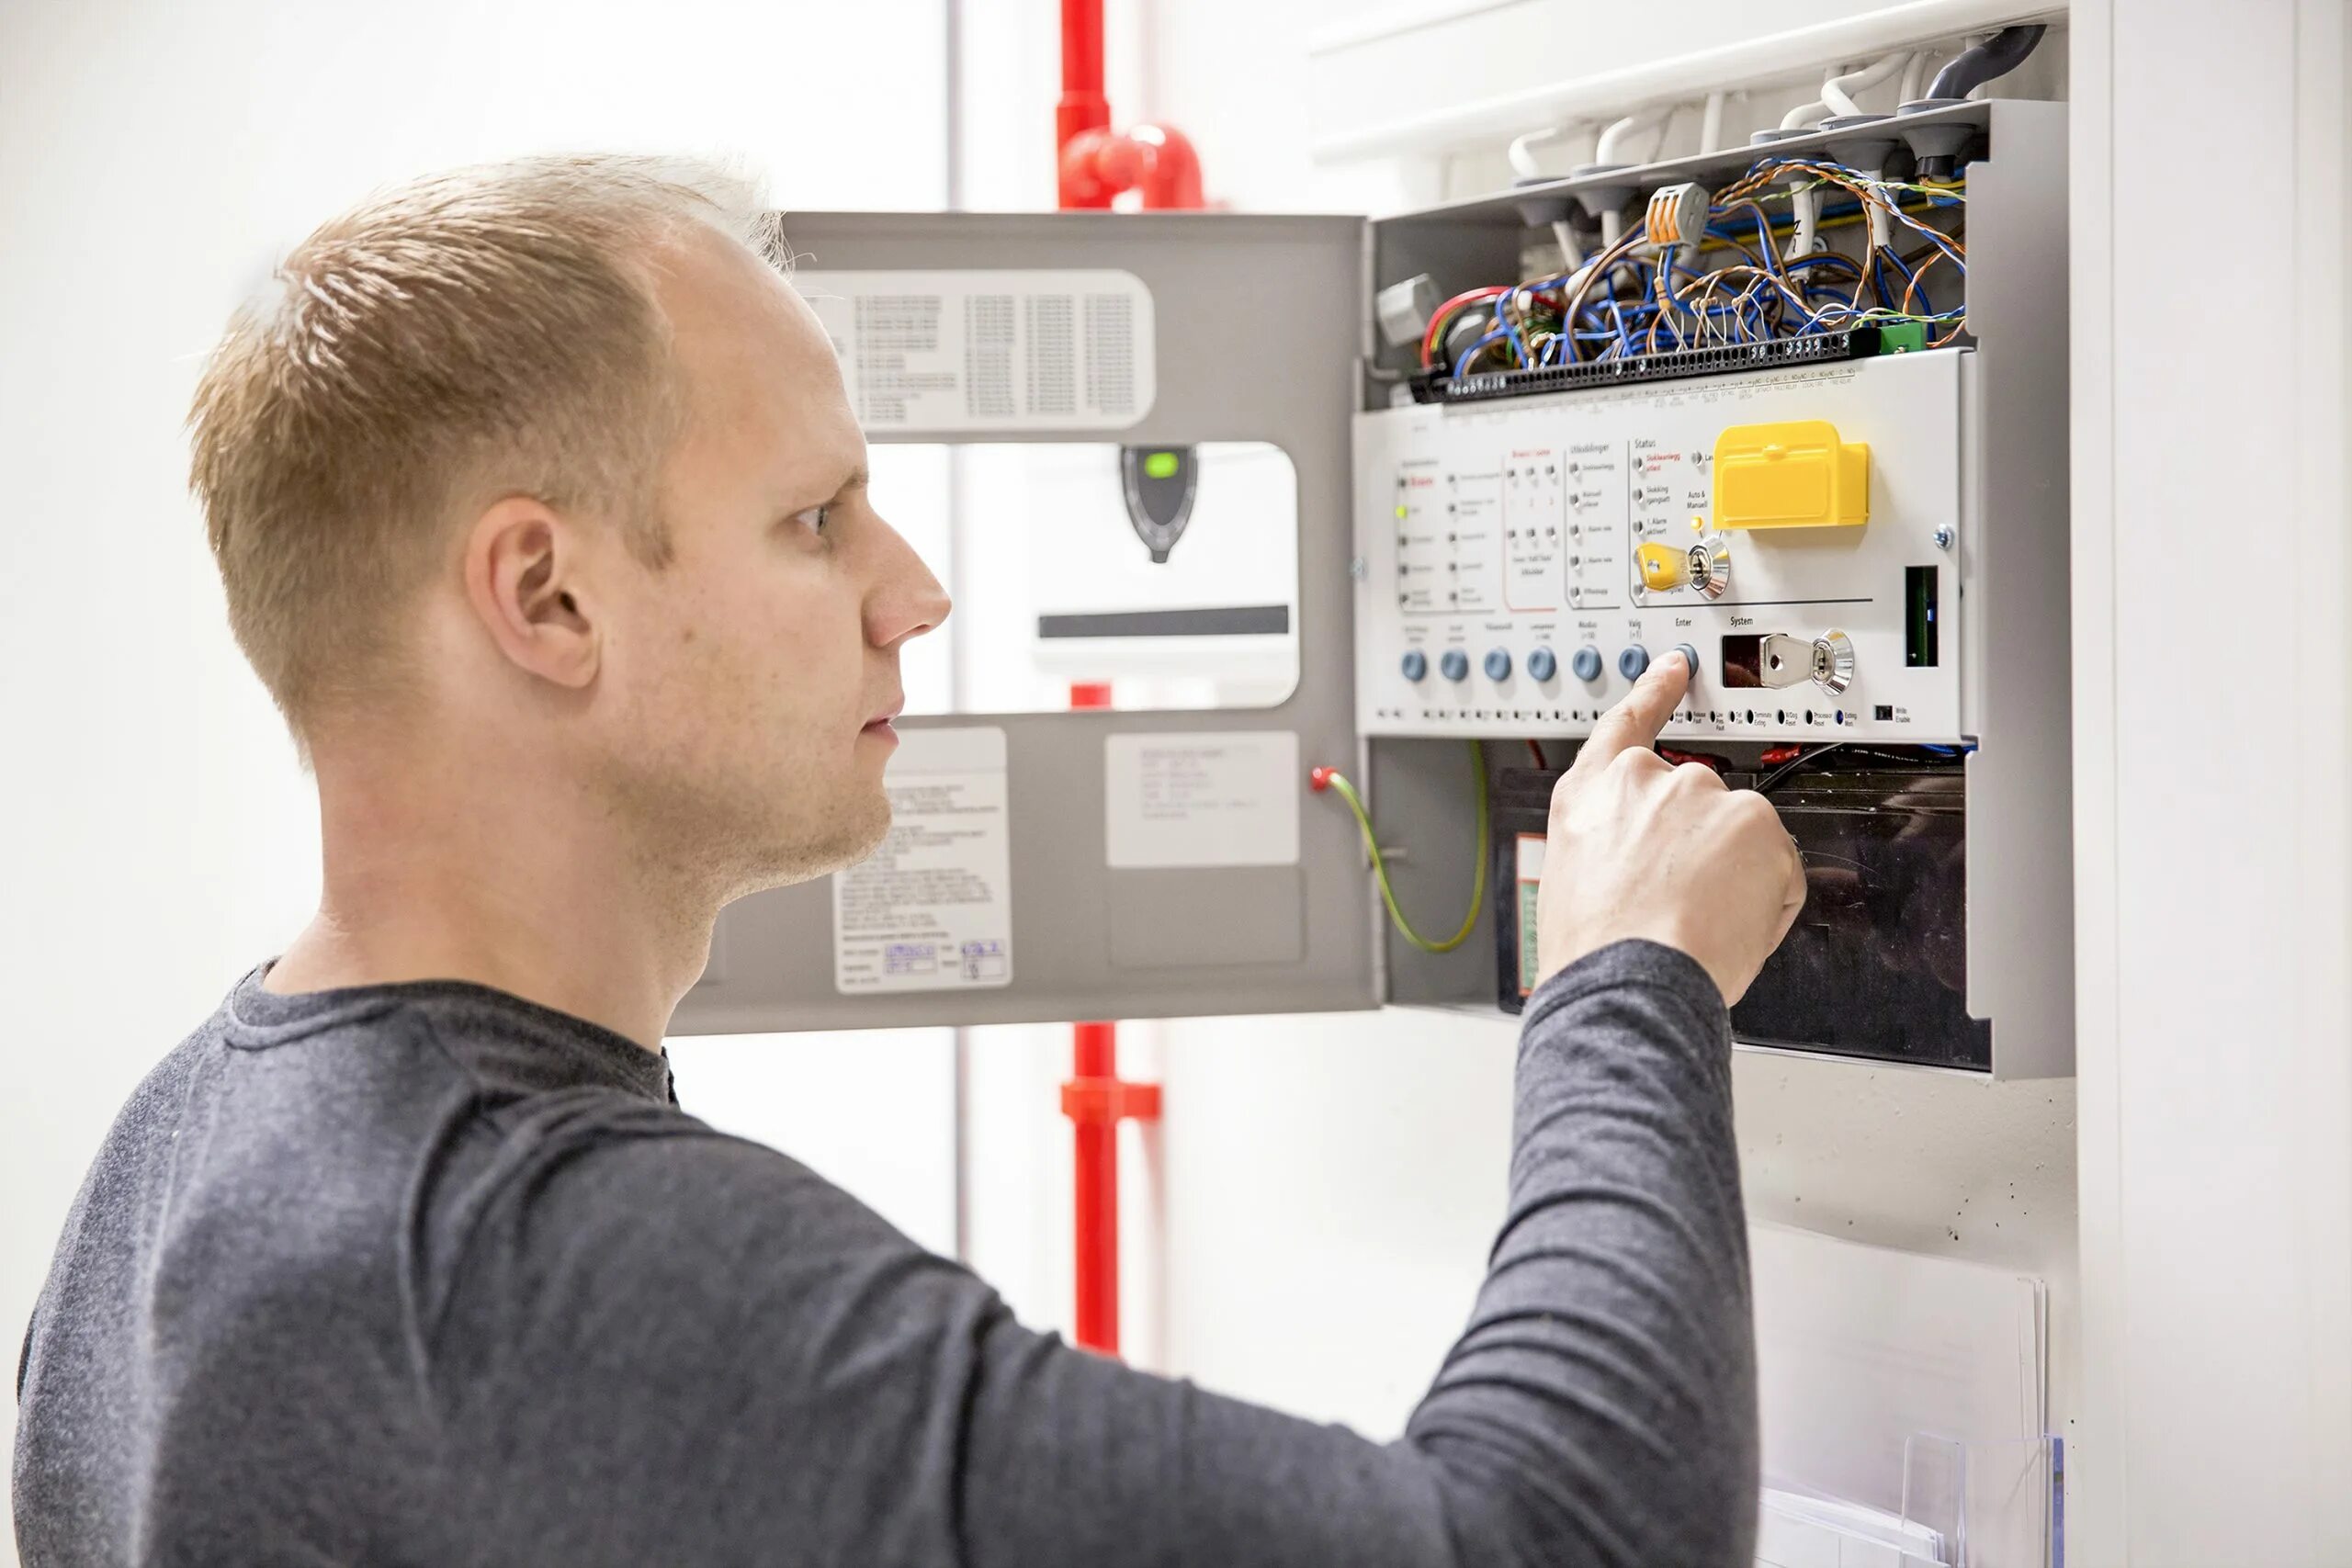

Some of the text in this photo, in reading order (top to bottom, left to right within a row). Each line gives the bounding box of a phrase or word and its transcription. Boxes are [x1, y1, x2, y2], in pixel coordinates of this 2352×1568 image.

[1635, 438, 1656, 448] Status
[1688, 491, 1701, 499] Auto
[1687, 500, 1708, 509] Manuell
[1628, 618, 1641, 630] Valg
[1675, 618, 1692, 627] Enter
[1730, 616, 1754, 627] System
